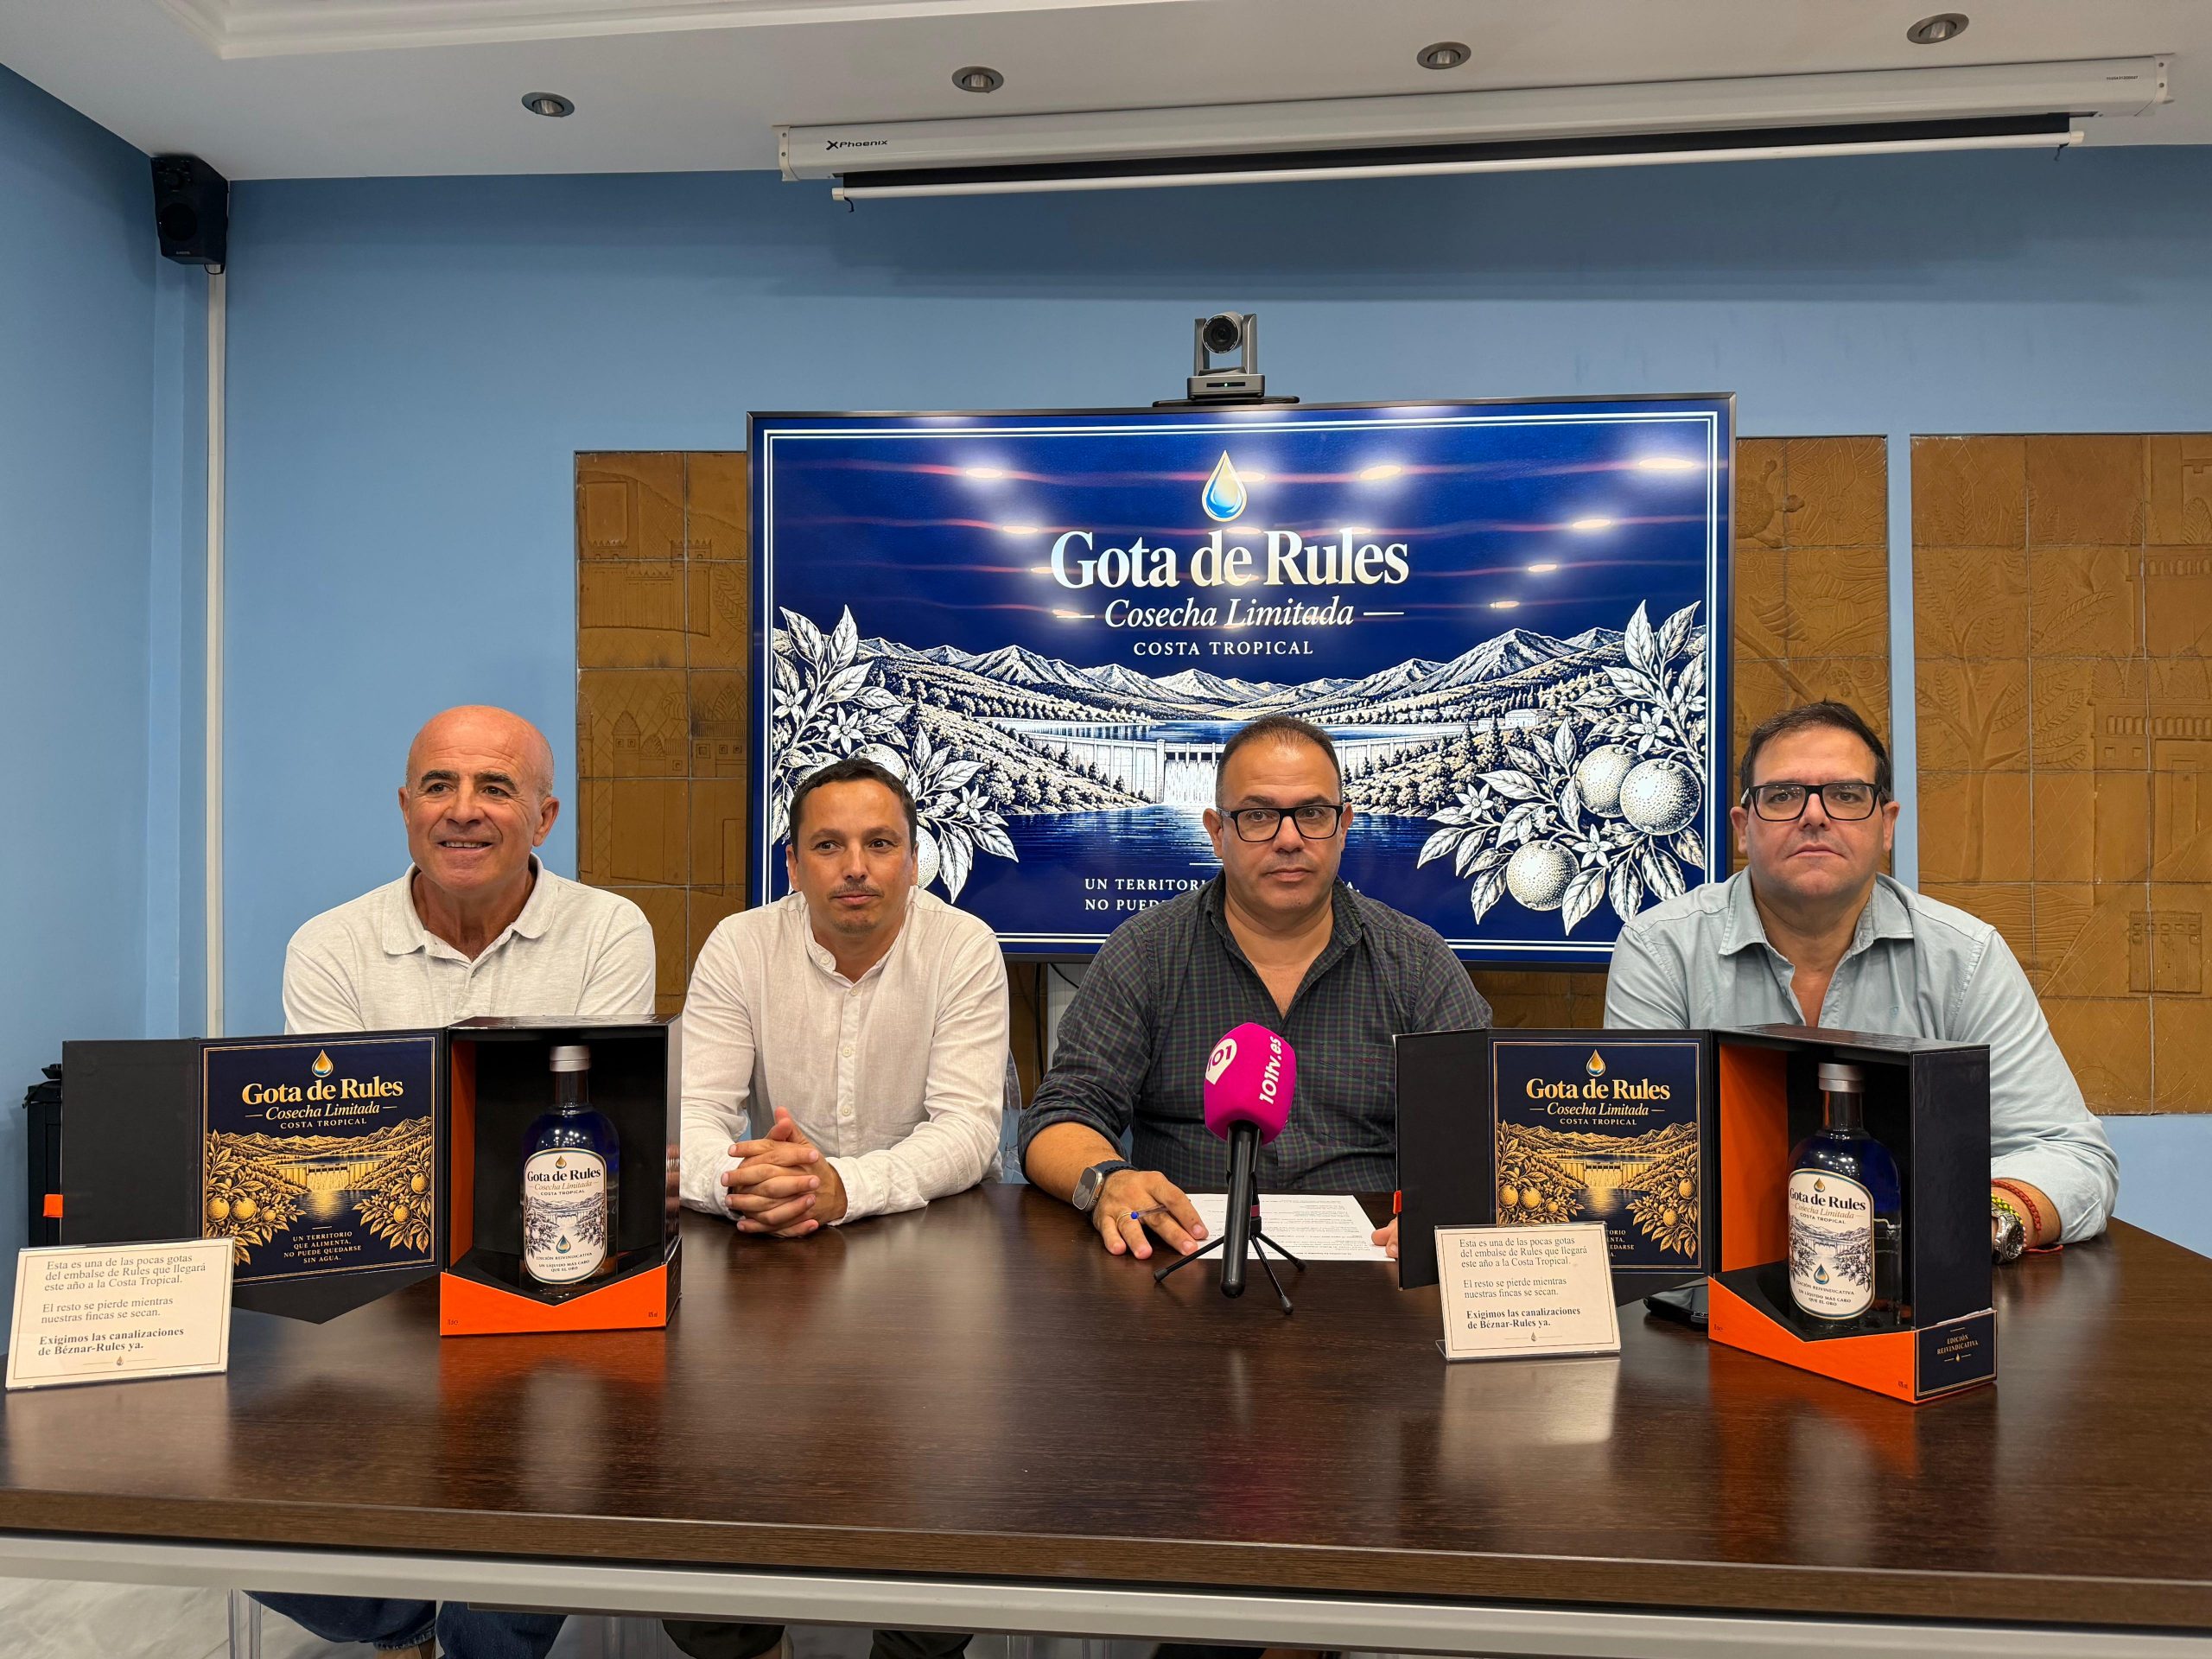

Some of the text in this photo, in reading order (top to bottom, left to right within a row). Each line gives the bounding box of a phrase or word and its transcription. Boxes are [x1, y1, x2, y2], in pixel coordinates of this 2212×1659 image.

[1050, 527, 1409, 589] Gota de Rules
[1104, 595, 1354, 628] Cosecha Limitada
[1133, 640, 1313, 657] COSTA TROPICAL
[1085, 879, 1206, 890] UN TERRITORI
[1085, 899, 1166, 911] NO PUED
[242, 1075, 404, 1104] Gota de Rules
[1526, 1078, 1671, 1100] Gota de Rules
[266, 1101, 380, 1120] Cosecha Limitada
[1547, 1101, 1649, 1116] Cosecha Limitada
[316, 1118, 366, 1127] TROPICAL
[528, 1168, 601, 1181] Gota de Rules
[1790, 1188, 1866, 1211] Gota de Rules
[1795, 1203, 1853, 1218] Cosecha Limitada
[306, 1231, 352, 1241] TERRITORIO
[1459, 1239, 1477, 1248] Esta
[1505, 1237, 1514, 1246] de
[1516, 1237, 1528, 1246] las
[1529, 1237, 1553, 1248] pocas
[1554, 1237, 1575, 1246] gotas
[324, 1245, 361, 1254] QUEDARSE
[1460, 1249, 1472, 1258] del
[1475, 1248, 1507, 1256] embalse
[1521, 1246, 1542, 1255] Rules
[1545, 1247, 1560, 1255] que
[1561, 1245, 1587, 1255] llegará
[47, 1261, 67, 1270] Esta
[105, 1258, 118, 1267] de
[120, 1257, 133, 1266] las
[137, 1256, 164, 1268] pocas
[167, 1255, 193, 1265] gotas
[1461, 1259, 1477, 1268] este
[1479, 1258, 1493, 1267] año
[1503, 1257, 1510, 1266] la
[1511, 1257, 1534, 1266] Costa
[1535, 1256, 1571, 1267] Tropical.
[46, 1263, 206, 1281] del embalse de Rules que llegará
[44, 1282, 64, 1292] este
[67, 1281, 85, 1290] año
[97, 1279, 105, 1288] la
[109, 1278, 137, 1287] Costa
[139, 1275, 182, 1287] Tropical.
[1464, 1279, 1472, 1287] El
[1474, 1279, 1493, 1287] resto
[1506, 1277, 1531, 1288] pierde
[1533, 1276, 1567, 1286] mientras
[1465, 1289, 1497, 1298] nuestras
[1499, 1287, 1522, 1297] fincas
[42, 1303, 54, 1313] El
[56, 1302, 81, 1312] resto
[97, 1300, 129, 1312] pierde
[131, 1297, 173, 1307] mientras
[1466, 1306, 1581, 1319] Exigimos las canalizaciones
[41, 1313, 82, 1324] nuestras
[86, 1311, 115, 1321] fincas
[130, 1308, 161, 1318] secan.
[1467, 1318, 1551, 1329] de Béznar-Rules ya.
[40, 1327, 184, 1346] Exigimos las canalizaciones
[38, 1342, 144, 1357] de Béznar-Rules ya.
